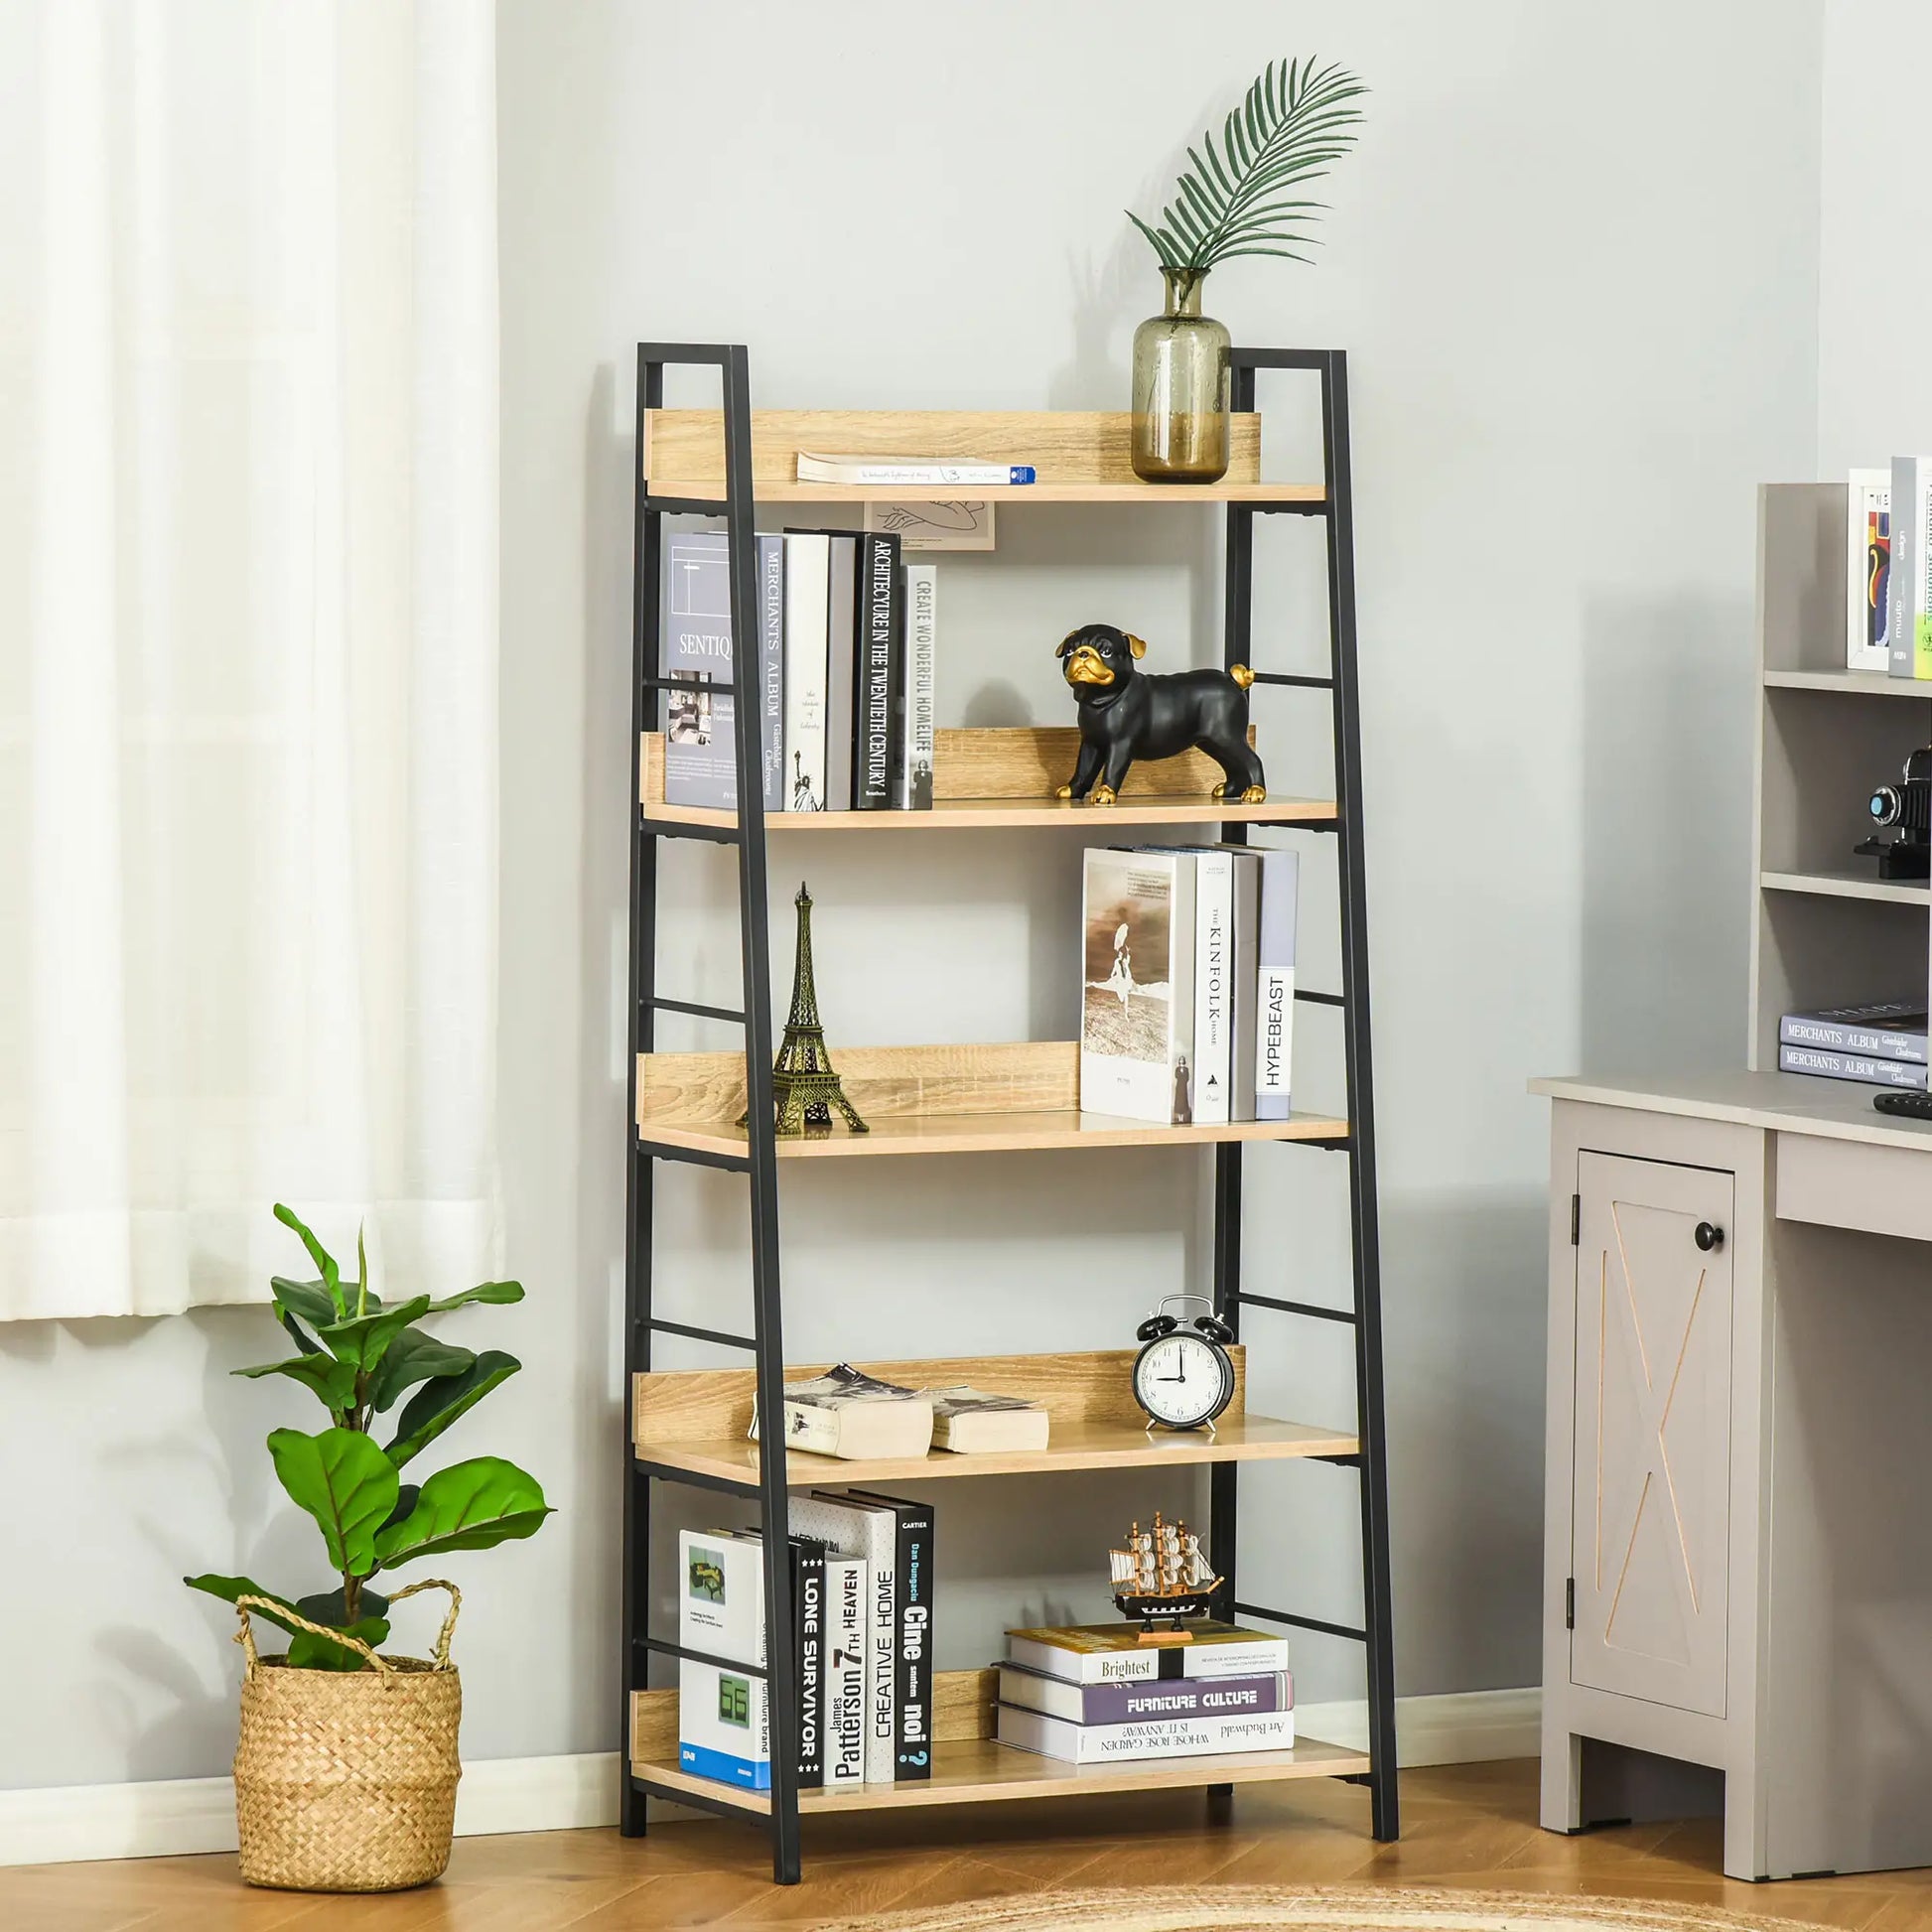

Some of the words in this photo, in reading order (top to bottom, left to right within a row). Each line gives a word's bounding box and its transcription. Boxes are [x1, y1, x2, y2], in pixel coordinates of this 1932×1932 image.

[768, 552, 779, 650] MERCHANTS
[916, 581, 931, 621] CREATE
[871, 643, 888, 666] THE
[872, 629, 889, 642] IN
[916, 624, 931, 693] WONDERFUL
[766, 661, 778, 716] ALBUM
[870, 667, 888, 733] TWENTIETH
[916, 697, 931, 751] HOMELIFE
[869, 734, 887, 787] CENTURY
[1209, 927, 1221, 1019] KINFOLK
[1266, 976, 1283, 1086] HYPEBEAST
[1787, 1024, 1842, 1044] MERCHANTS
[1847, 1034, 1878, 1050] ALBUM
[1786, 1051, 1840, 1071] MERCHANTS
[1845, 1060, 1874, 1076] ALBUM
[804, 1578, 819, 1634] LONE
[843, 1570, 857, 1629] HEAVEN
[877, 1571, 893, 1628] HOME
[903, 1606, 927, 1660] Cine
[876, 1638, 892, 1738] CREATIVE
[1102, 1660, 1150, 1679] Brightest
[802, 1640, 817, 1757] SURVIVOR
[829, 1697, 842, 1732] James
[1127, 1694, 1197, 1713] FURNITURE
[1202, 1690, 1257, 1707] CULTURE
[835, 1670, 861, 1779] Patterson
[904, 1704, 927, 1743] noi
[1122, 1725, 1165, 1737] ANYWAY?
[1146, 1736, 1171, 1748] ROSE
[1167, 1724, 1176, 1733] IT
[1173, 1734, 1209, 1747] WHOSE
[1180, 1723, 1188, 1732] IS
[1221, 1723, 1267, 1738] Buchwald
[1270, 1722, 1285, 1733] Art
[898, 1750, 928, 1766] ?
[1101, 1738, 1143, 1751] GARDEN
